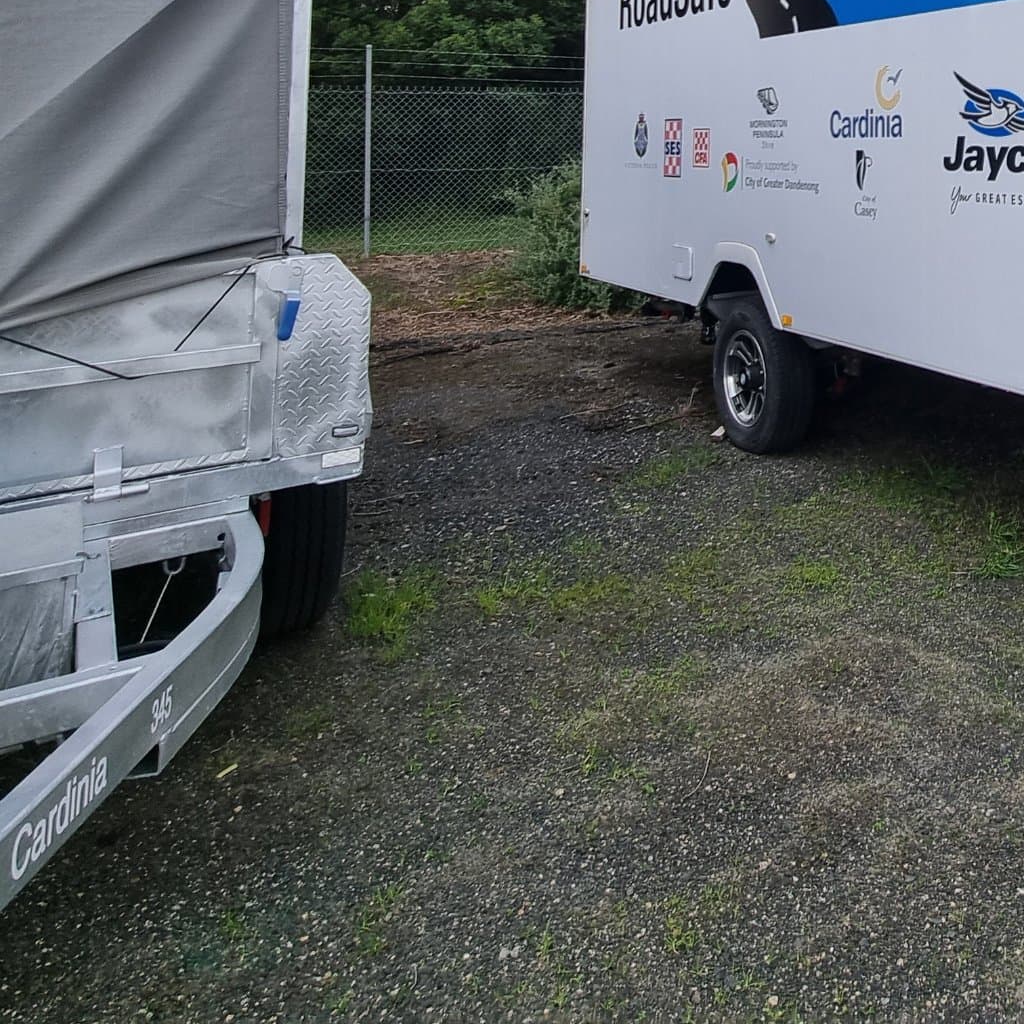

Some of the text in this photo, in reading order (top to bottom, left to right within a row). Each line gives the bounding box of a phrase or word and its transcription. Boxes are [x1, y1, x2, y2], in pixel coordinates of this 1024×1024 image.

[830, 108, 903, 138] Cardinia
[664, 141, 681, 156] SES
[694, 152, 708, 165] CFA
[745, 177, 756, 190] City
[975, 192, 1007, 205] GREAT
[854, 201, 878, 221] Casey
[151, 684, 173, 734] 345
[11, 756, 108, 881] Cardinia
